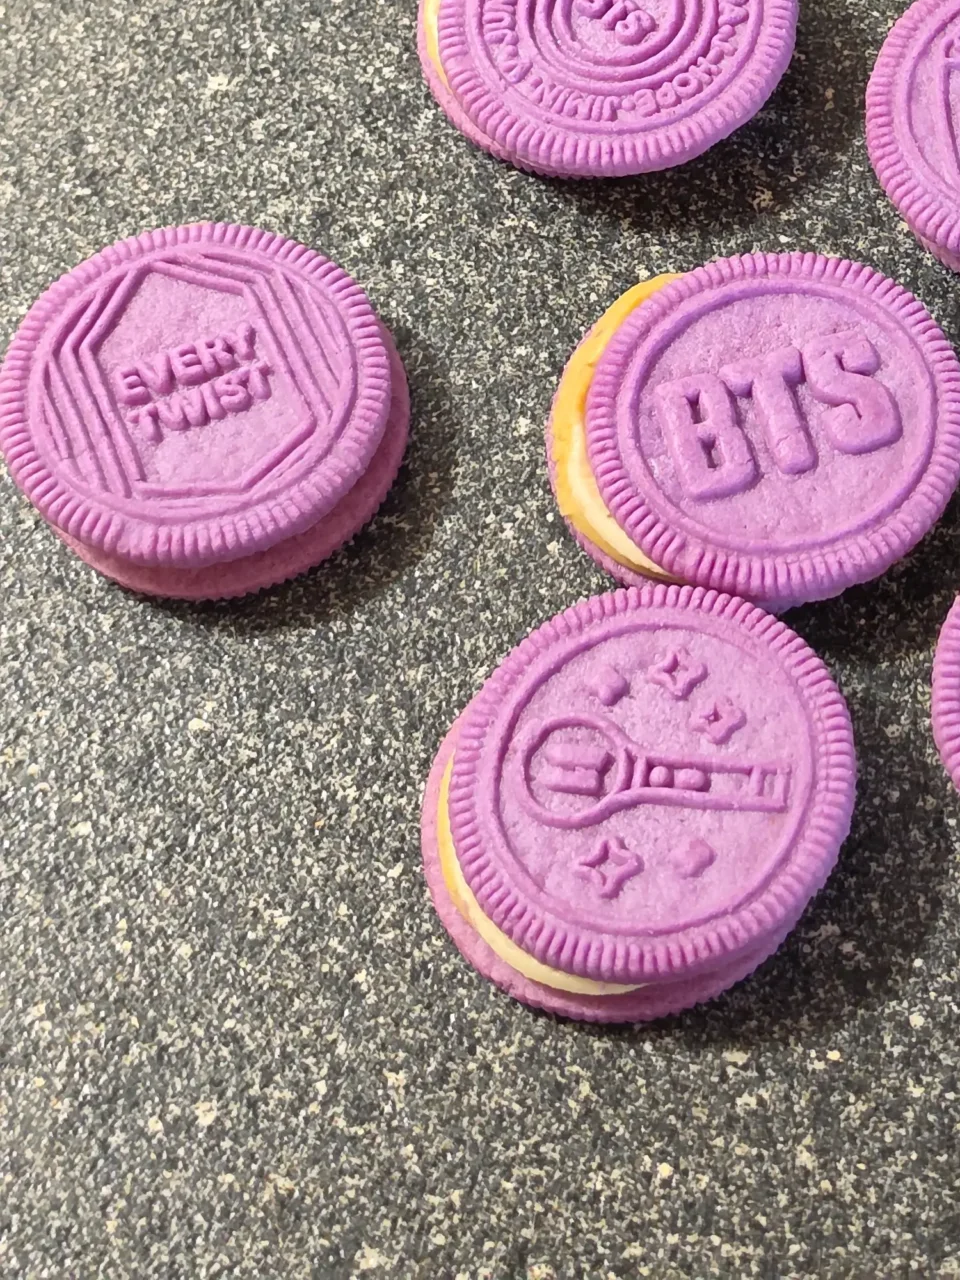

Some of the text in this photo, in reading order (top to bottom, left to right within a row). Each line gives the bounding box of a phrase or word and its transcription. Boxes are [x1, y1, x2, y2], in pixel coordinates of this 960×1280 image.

[533, 81, 622, 122] JIMIN
[116, 323, 258, 407] EVERY
[126, 359, 274, 445] TWIST
[656, 330, 903, 501] BTS
